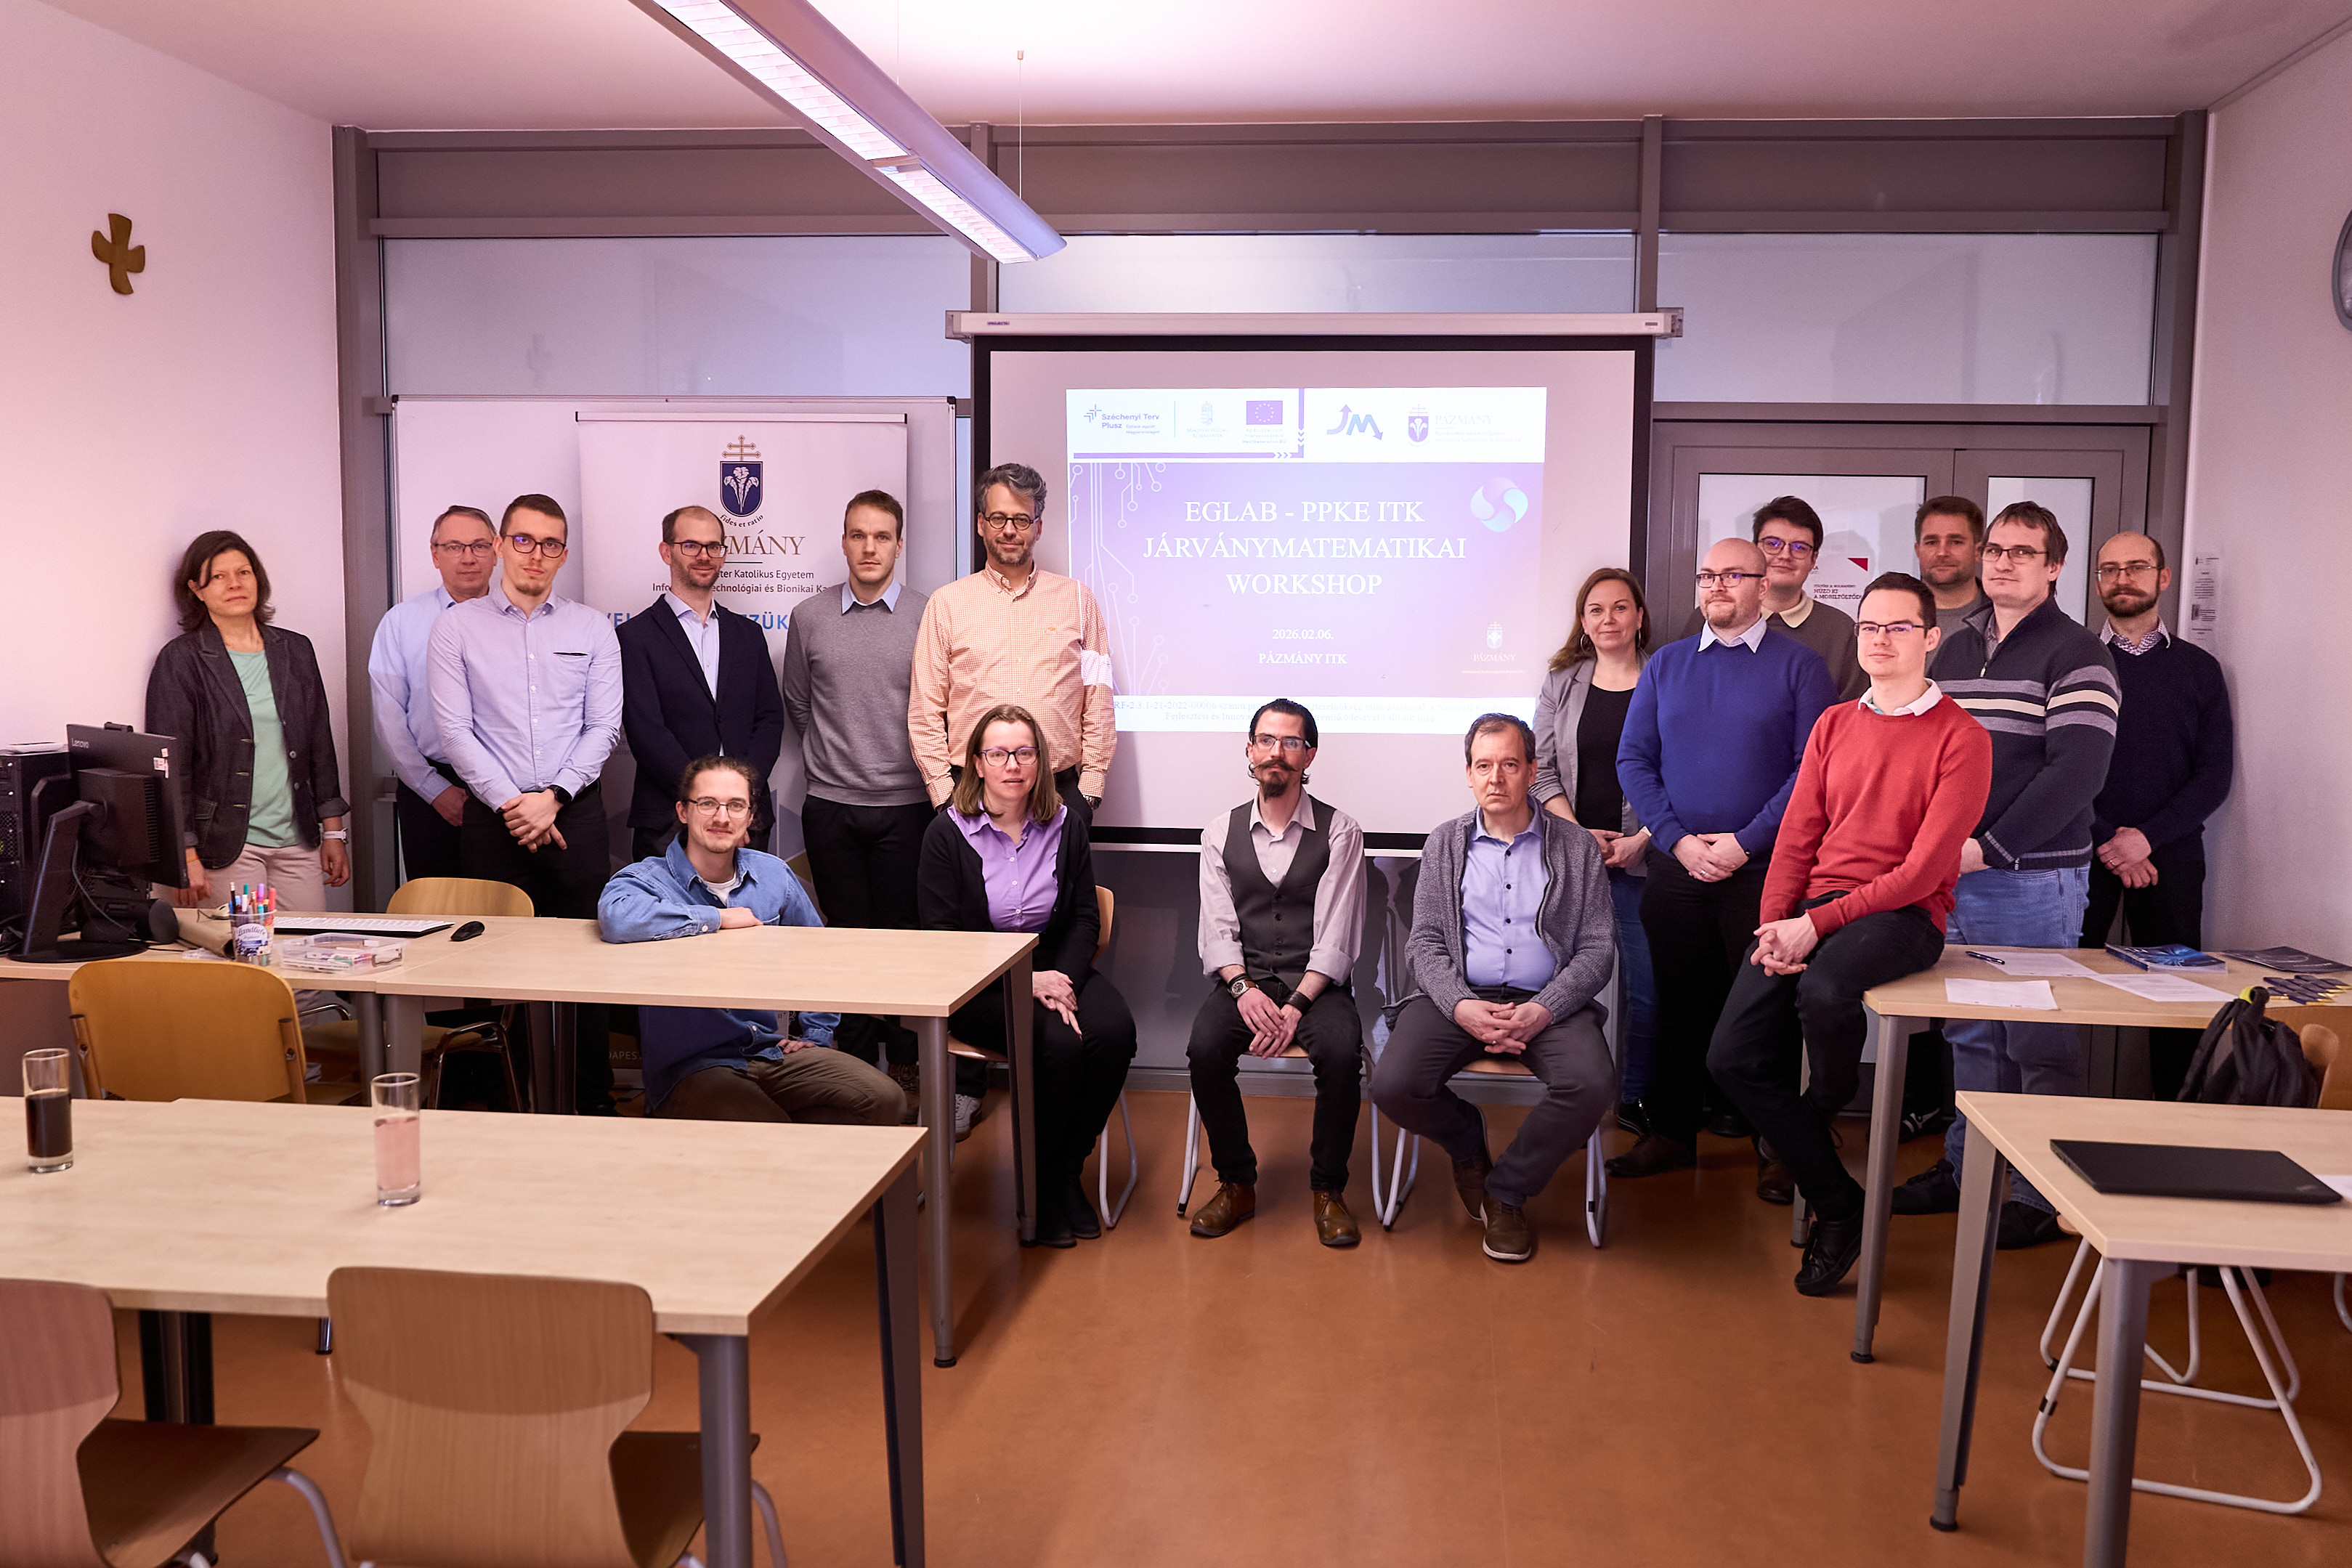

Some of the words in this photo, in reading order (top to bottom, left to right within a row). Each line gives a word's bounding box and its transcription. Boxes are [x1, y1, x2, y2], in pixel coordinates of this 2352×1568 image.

[1435, 413, 1493, 427] PÁZMÁNY
[1184, 501, 1278, 522] EGLAB
[1301, 501, 1371, 522] PPKE
[1377, 501, 1425, 522] ITK
[720, 514, 737, 527] fides
[747, 514, 763, 527] ratio
[724, 529, 806, 555] MÁNY
[1143, 532, 1467, 558] JÁRVÁNYMATEMATIKAI
[734, 569, 774, 578] Katolikus
[776, 570, 814, 580] Egyetem
[712, 583, 762, 594] echnológiai
[764, 584, 774, 593] és
[1225, 574, 1382, 595] WORKSHOP
[1272, 629, 1334, 640] 2026.02.06.
[1258, 650, 1323, 664] PÁZMÁNY
[1325, 654, 1348, 665] ITK
[1473, 651, 1517, 662] PÁZMÁNY
[1114, 701, 1217, 710] RF-2.3.1-21-2022-00006
[1305, 702, 1363, 712] szterelnökség
[1165, 713, 1209, 723] Fejlesztési
[71, 737, 89, 749] Lenovo
